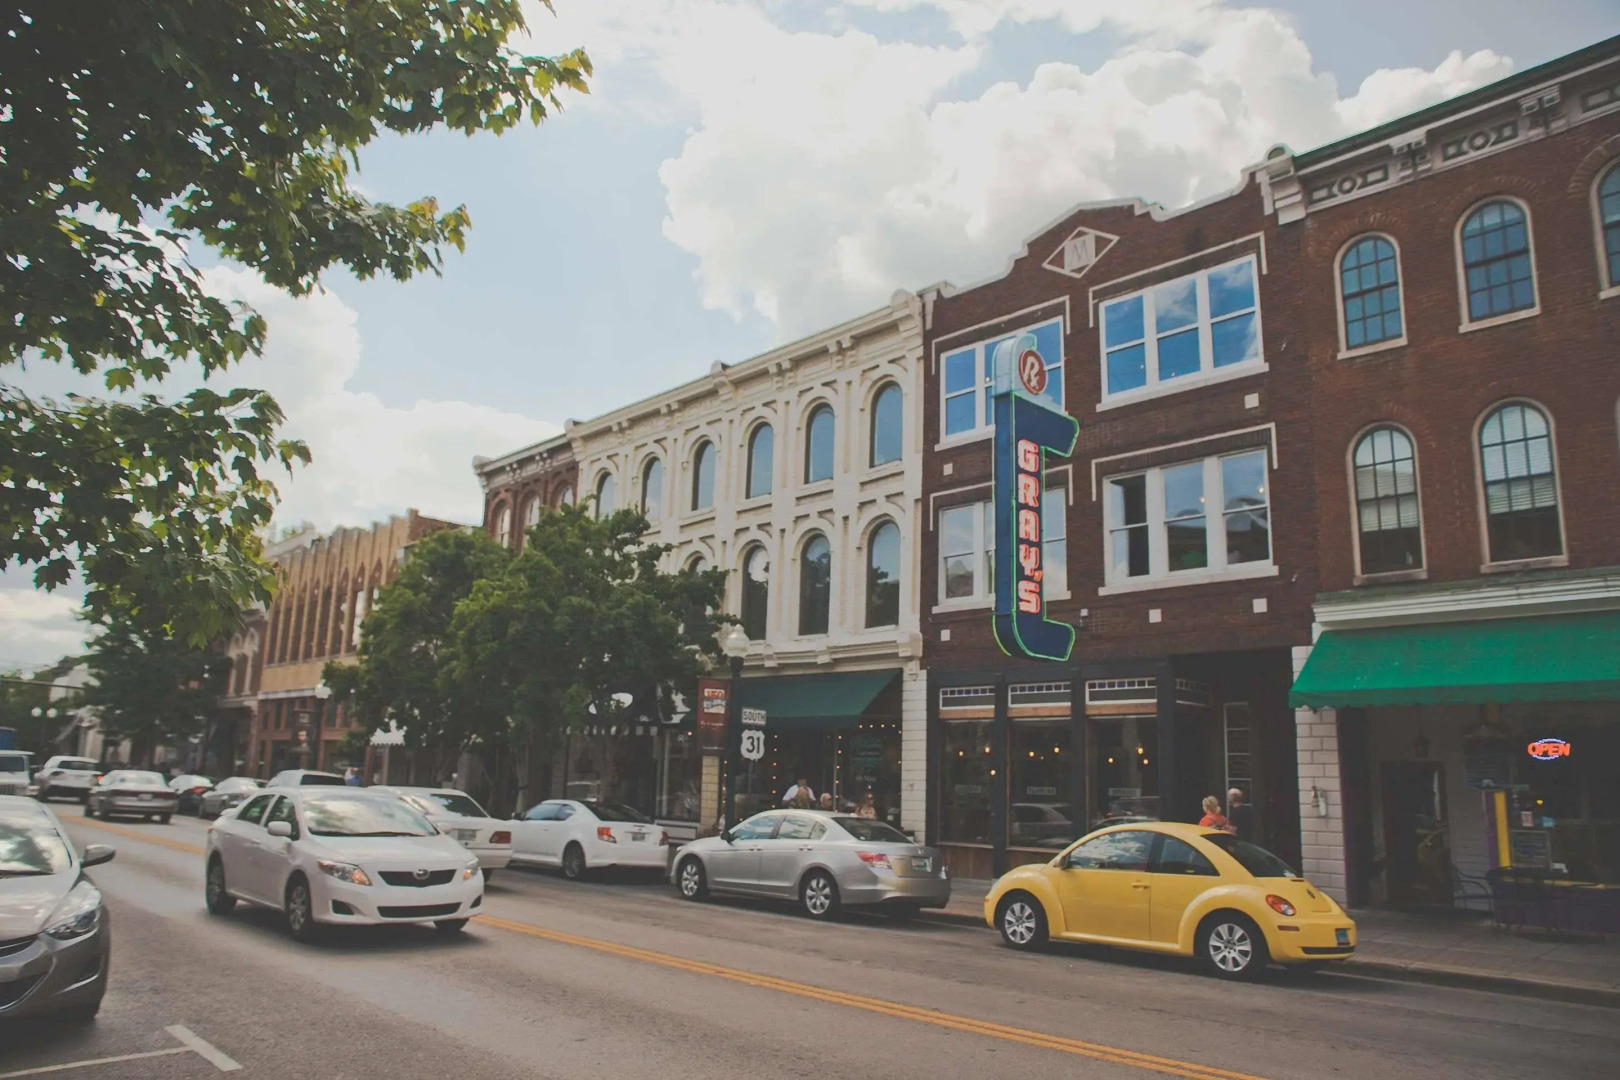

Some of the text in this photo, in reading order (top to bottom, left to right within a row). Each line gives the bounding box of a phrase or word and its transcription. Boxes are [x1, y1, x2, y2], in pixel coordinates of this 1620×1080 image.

[1018, 439, 1043, 614] GRAY'S
[743, 711, 766, 722] SOUTH
[746, 735, 760, 753] 31
[1527, 742, 1571, 756] OPEN
